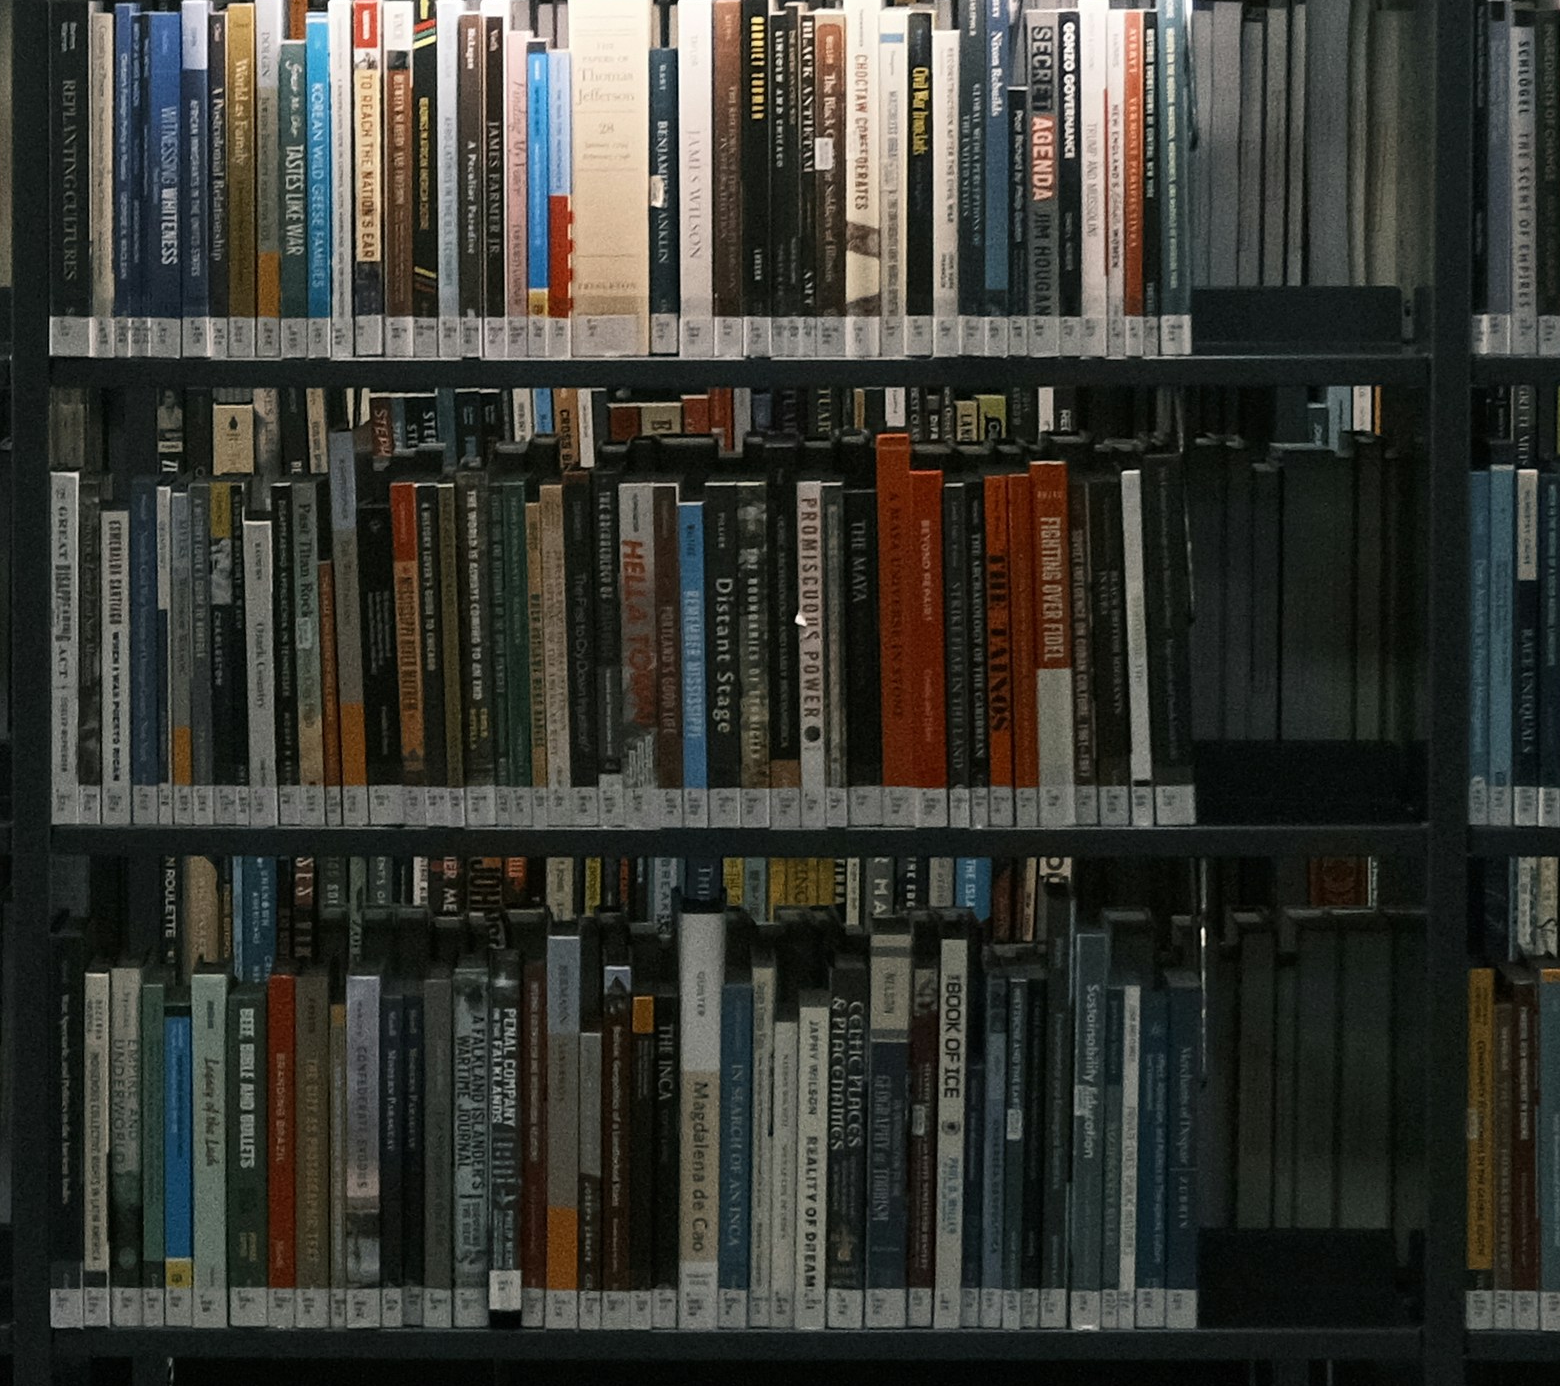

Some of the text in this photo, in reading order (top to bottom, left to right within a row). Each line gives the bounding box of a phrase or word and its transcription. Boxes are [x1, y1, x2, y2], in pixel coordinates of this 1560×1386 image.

[360, 75, 375, 259] TO REACH THE NATION'S EAR
[1062, 22, 1076, 159] GONZO GOVERNANCE
[160, 106, 178, 265] WITNESSING WHITENESS
[286, 144, 304, 255] TASTES LIKE WAR
[310, 83, 325, 287] KOREAN WILD GEESE FAMILIES
[1031, 26, 1055, 316] SECRET AGENDA JIM HOUGAN
[622, 539, 646, 626] HELLA
[802, 498, 820, 718] PROMISCUOUS POWER
[851, 520, 866, 602] THE MAYA
[1040, 516, 1064, 662] FIGHTING OVER FIDEL
[714, 577, 733, 733] Distant Stage
[944, 981, 960, 1099] BOOK OF ICE
[690, 1081, 709, 1252] Magdalena de Cao
